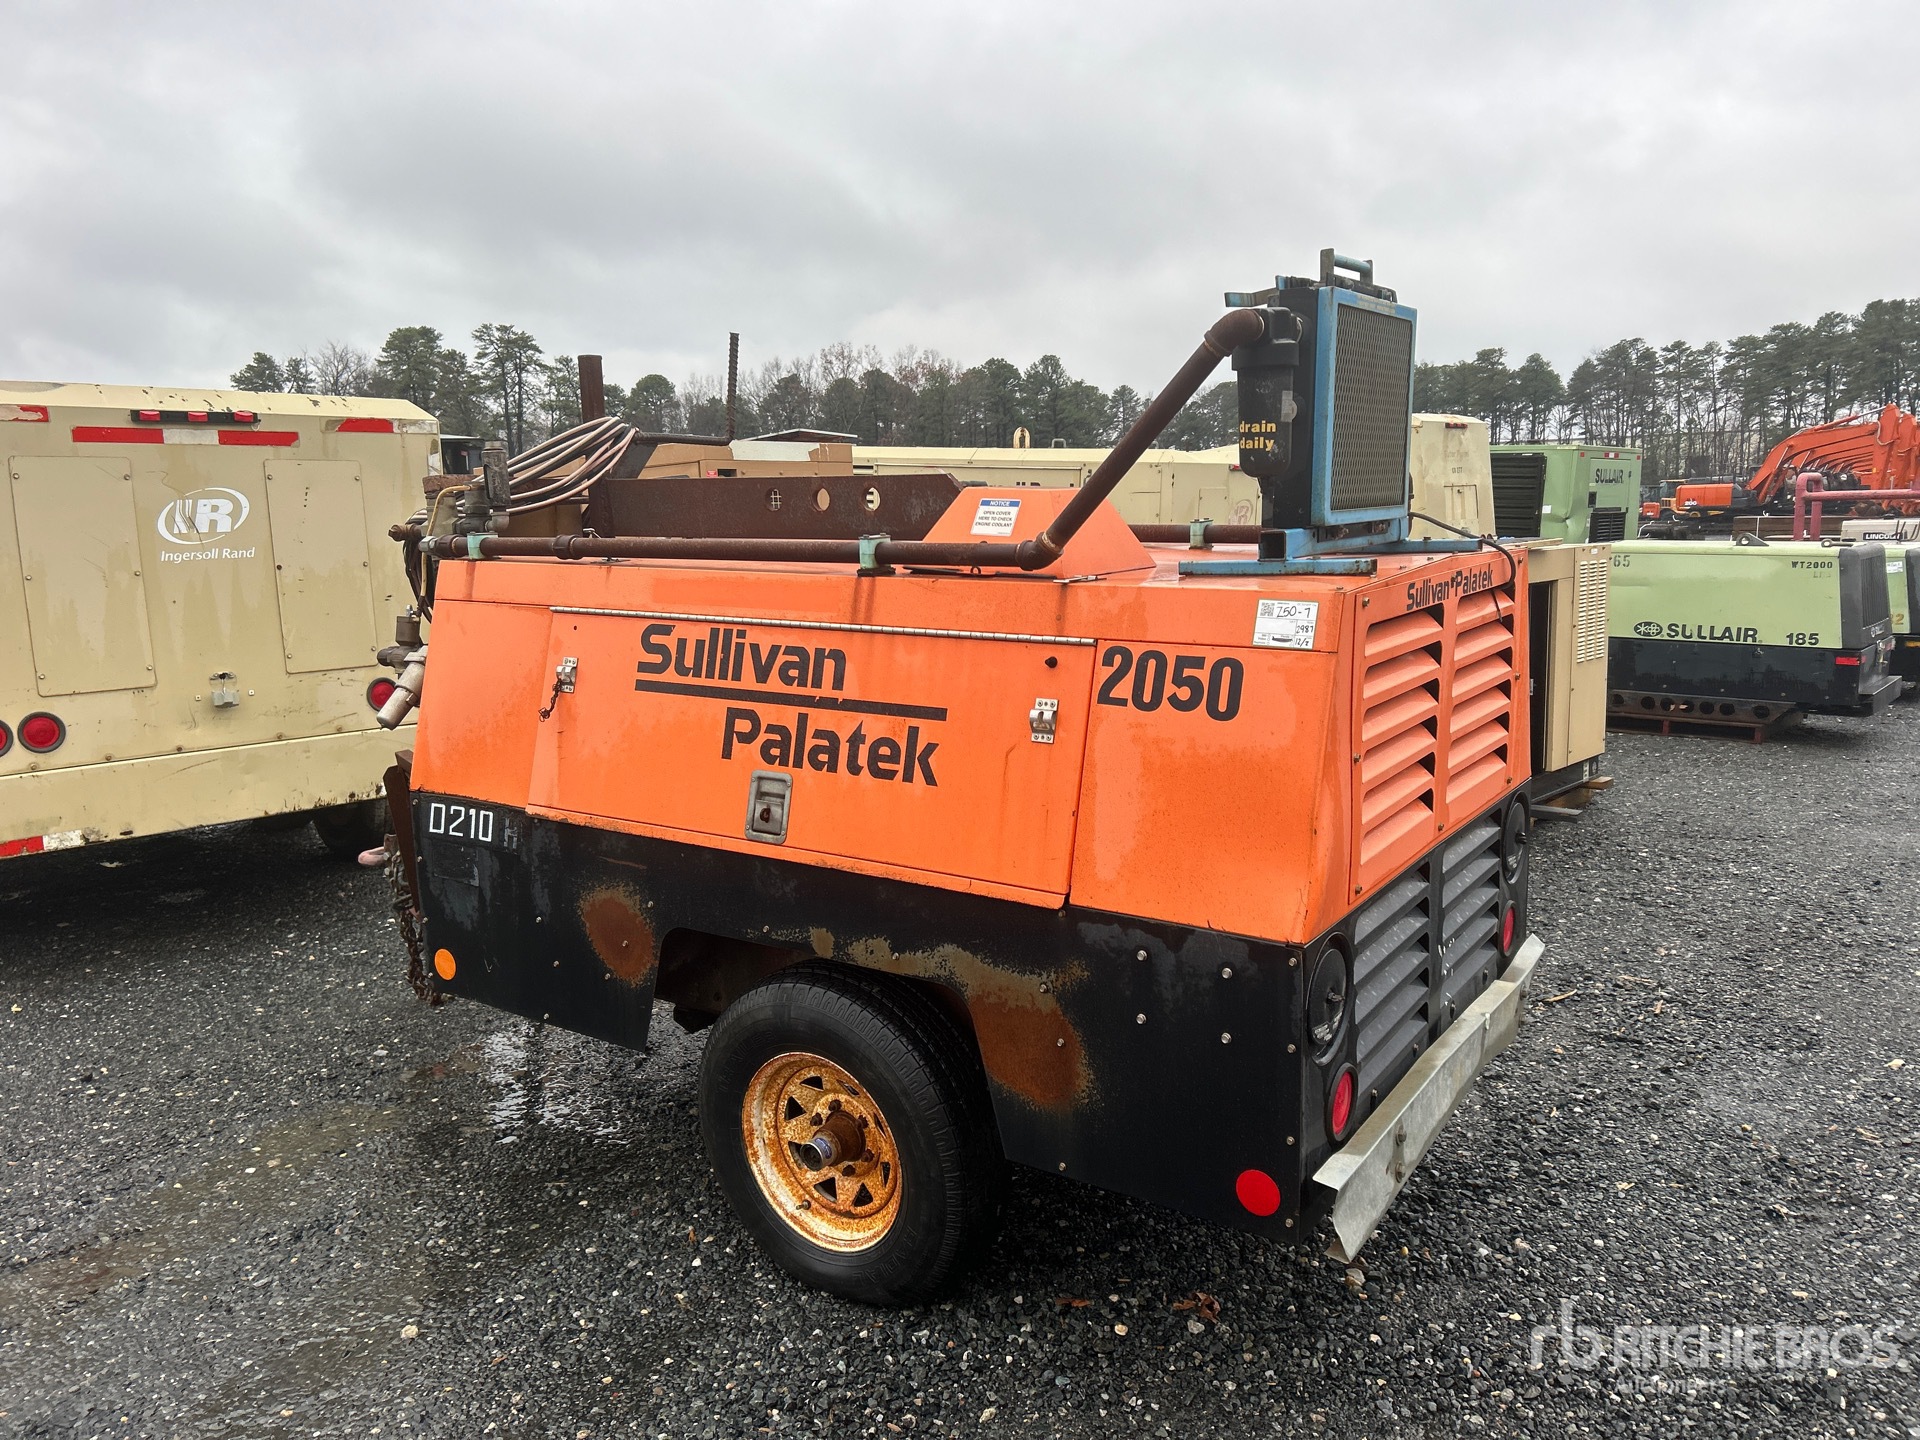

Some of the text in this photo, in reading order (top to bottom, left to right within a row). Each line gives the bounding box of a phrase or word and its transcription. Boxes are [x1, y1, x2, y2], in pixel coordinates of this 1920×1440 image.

[1239, 420, 1277, 433] drain
[1239, 437, 1275, 452] daily
[1595, 468, 1624, 484] SULLAIR
[160, 546, 256, 564] Ingersoll Rand
[1791, 560, 1833, 569] WT2000
[1406, 563, 1493, 611] Sullivan Palatek
[1666, 623, 1820, 646] SULLAIR 185
[635, 623, 846, 692] Sullivan
[1096, 645, 1245, 722] 2050
[720, 705, 939, 788] Palatek
